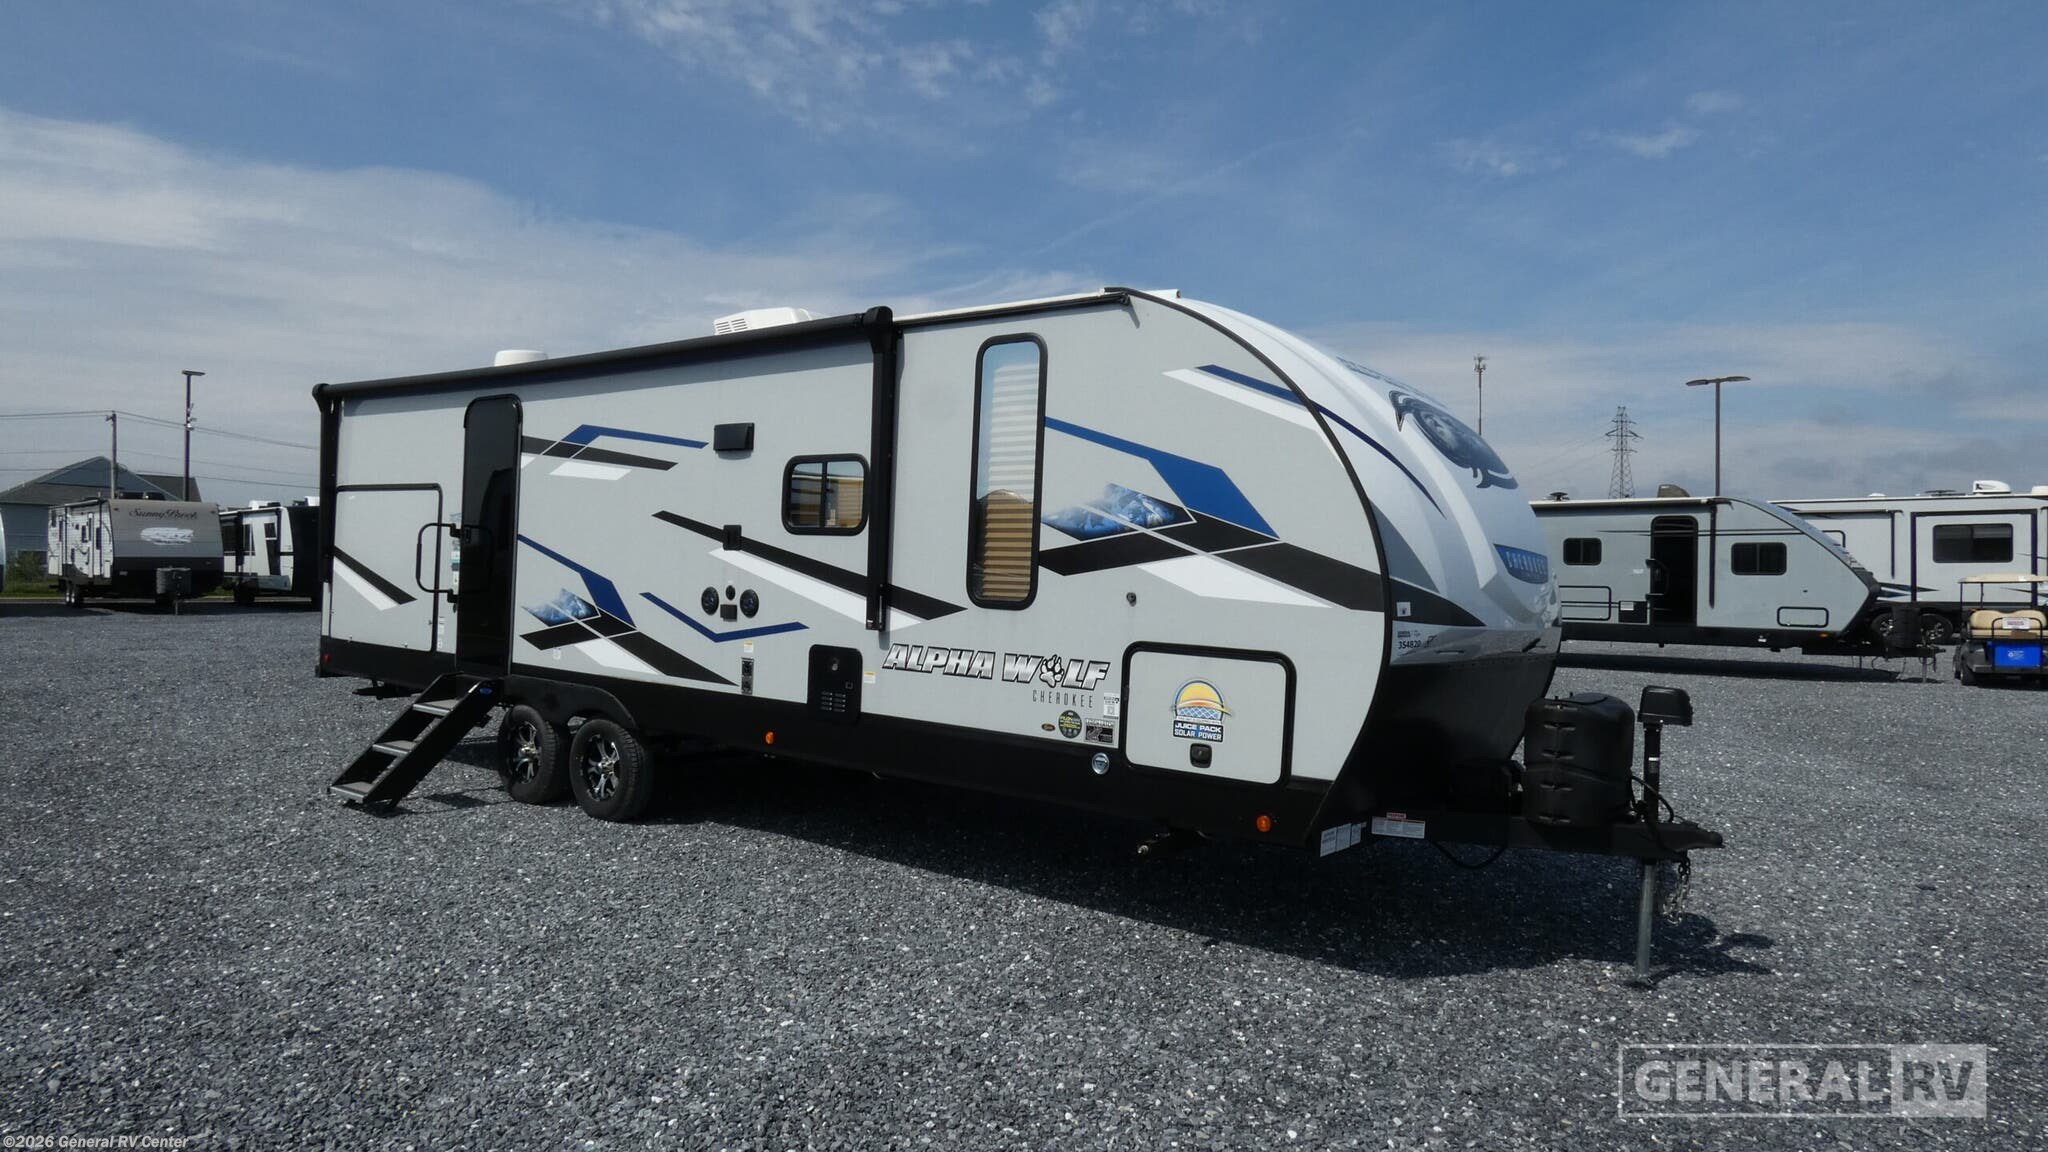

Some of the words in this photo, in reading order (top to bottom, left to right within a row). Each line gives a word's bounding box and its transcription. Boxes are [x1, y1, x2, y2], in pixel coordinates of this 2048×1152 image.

[882, 643, 996, 680] ALPHA
[1032, 690, 1094, 708] CHEROKEE
[1174, 729, 1196, 738] SOLAR
[1198, 731, 1222, 741] POWER
[1175, 722, 1197, 731] JUICE
[1199, 725, 1222, 733] PACK
